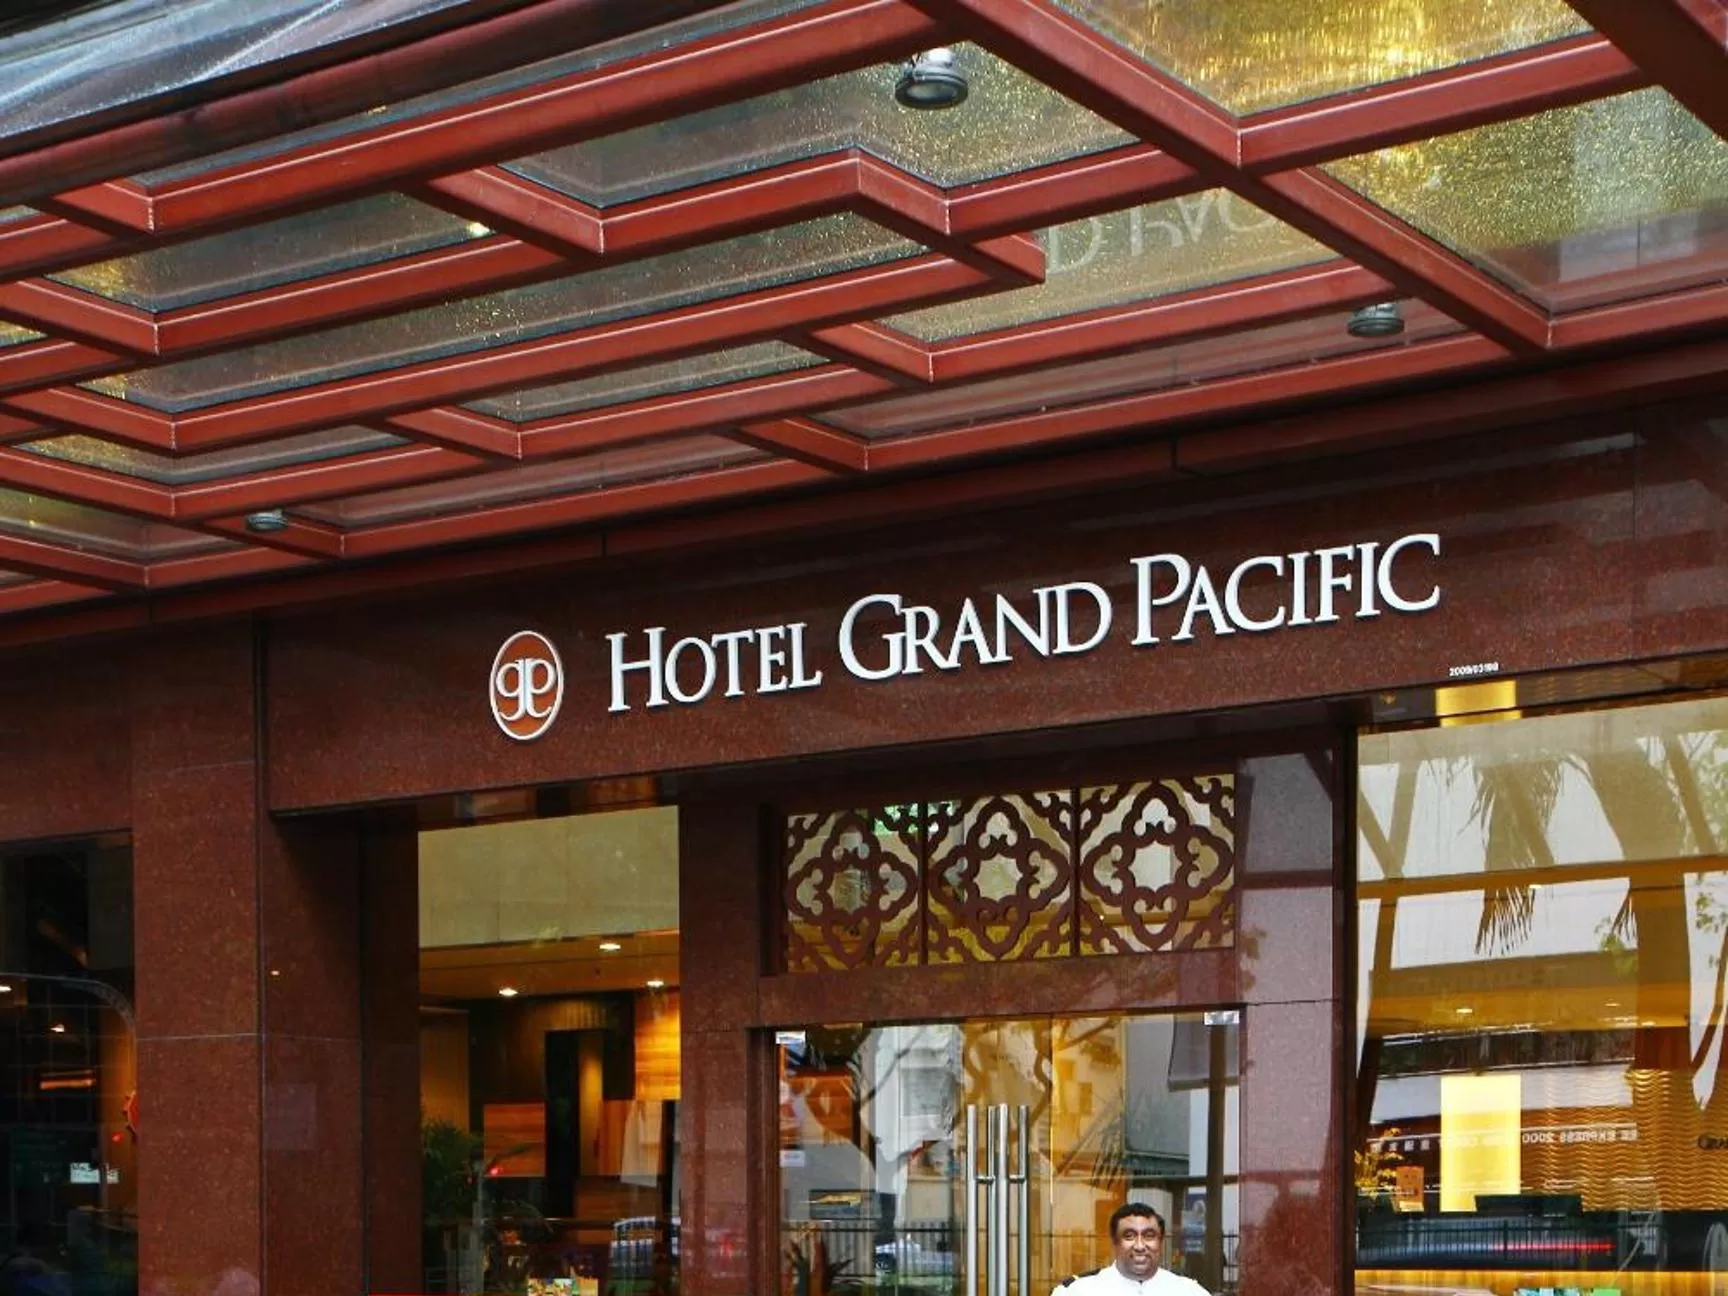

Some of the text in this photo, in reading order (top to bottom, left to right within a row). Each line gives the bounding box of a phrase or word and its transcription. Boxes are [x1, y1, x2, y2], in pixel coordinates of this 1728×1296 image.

[605, 533, 1441, 712] HOTEL GRAND PACIFIC
